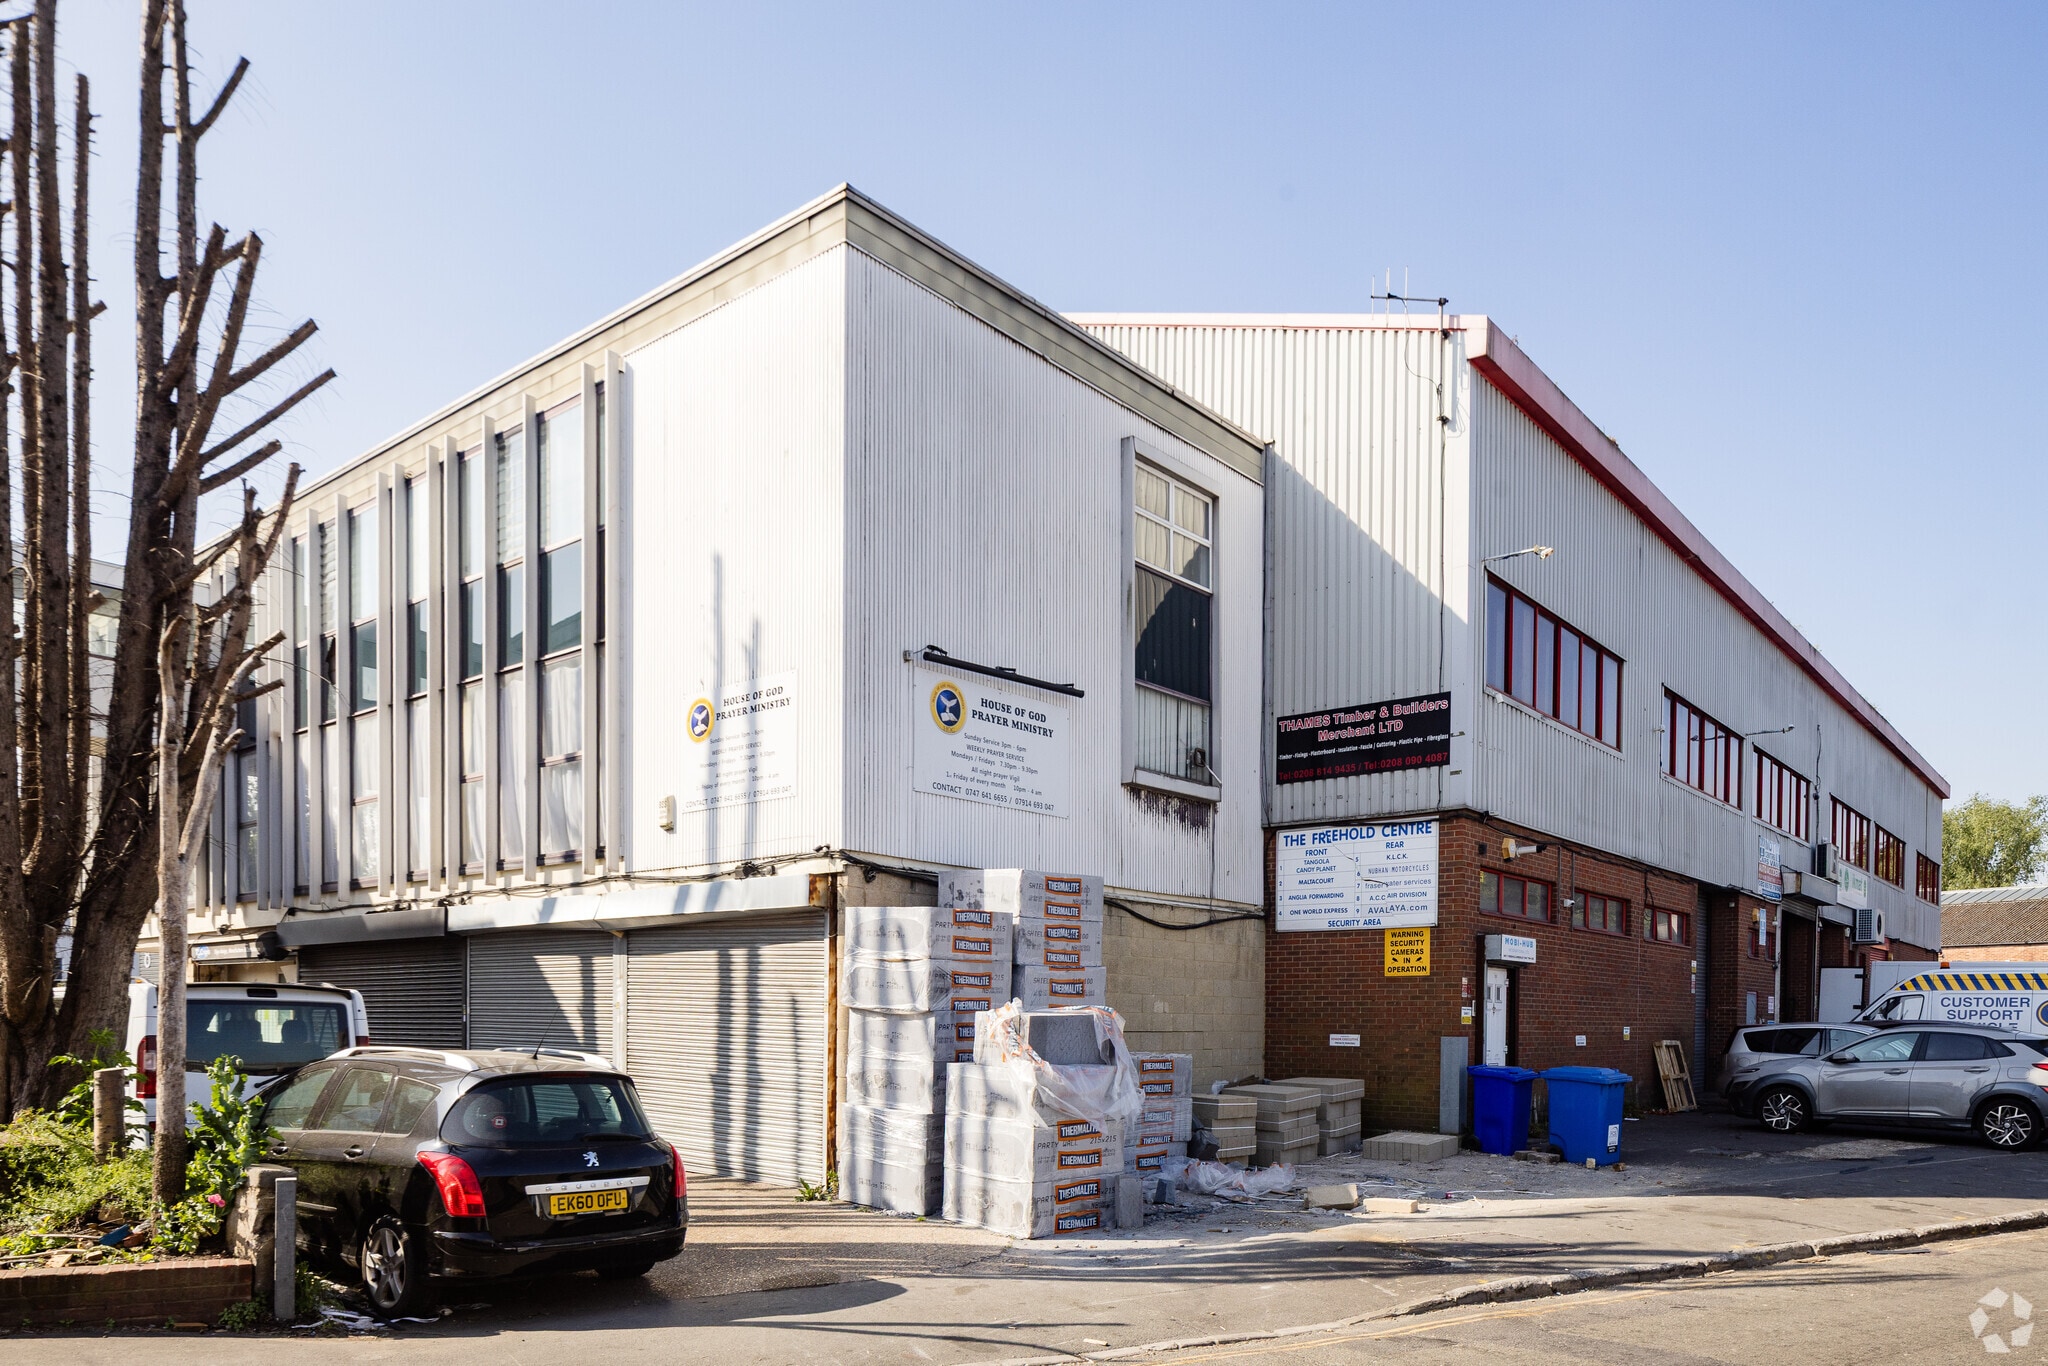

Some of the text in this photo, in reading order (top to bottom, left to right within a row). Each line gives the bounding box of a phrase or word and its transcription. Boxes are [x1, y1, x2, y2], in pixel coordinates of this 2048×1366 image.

[724, 686, 784, 707] HOUSE OF GOD
[716, 697, 791, 720] PRAYER MINISTRY
[980, 698, 1046, 723] HOUSE OF GOD
[1279, 700, 1448, 732] THAMES Timber & Builders
[972, 710, 1054, 738] PRAYER MINISTRY
[1318, 720, 1403, 741] Merchant LTD
[964, 733, 982, 743] Sunday
[983, 737, 1000, 747] Service
[951, 750, 973, 761] Mondays
[979, 756, 995, 766] Fridays
[966, 744, 1024, 762] WEEKLY PRAYER SERVICE
[1335, 764, 1356, 773] 9435
[1364, 758, 1402, 770] Tel:0208
[1406, 756, 1422, 765] 090
[1425, 752, 1448, 762] 4087
[980, 769, 992, 777] night
[993, 772, 1008, 780] prayer
[953, 773, 968, 782] Friday
[976, 779, 989, 787] every
[991, 781, 1006, 789] month
[1014, 785, 1026, 793] 10pm
[932, 782, 962, 794] CONTACT
[965, 788, 979, 798] 0747
[982, 791, 992, 800] 641
[994, 794, 1008, 803] 6655
[1015, 798, 1032, 807] 07914
[1033, 801, 1043, 810] 693
[1044, 803, 1054, 811] 047
[1284, 822, 1432, 847] THE FREEHOLD CENTRE
[1306, 848, 1327, 856] FRONT
[1392, 864, 1429, 873] MOTORCYCLES
[1048, 880, 1080, 893] THERMALITE
[1048, 905, 1079, 916] THERMALITE
[1368, 904, 1428, 914] AVALAYA.com
[956, 912, 990, 924] THERMALITE
[1328, 919, 1360, 927] SECURITY
[1047, 928, 1079, 939] THERMALITE
[956, 940, 990, 951] THERMALITE
[1505, 938, 1533, 948] MOBI-HUB
[1047, 953, 1078, 962] THERMALITE
[955, 975, 989, 985] THERMALITE
[1052, 983, 1082, 994] THERMALITE
[954, 1001, 988, 1010] THERMALITE
[1941, 997, 2030, 1007] CUSTOMER
[1947, 1010, 2023, 1020] SUPPORT
[1144, 1062, 1172, 1070] THERMALITE
[1143, 1084, 1171, 1093] THERMALITE
[1090, 1135, 1116, 1144] 215x215
[1062, 1154, 1099, 1165] THERMALITE
[1059, 1184, 1097, 1200] THERMALITE
[557, 1192, 621, 1211] EK60 OFU
[1059, 1217, 1096, 1229] THERMALITE
